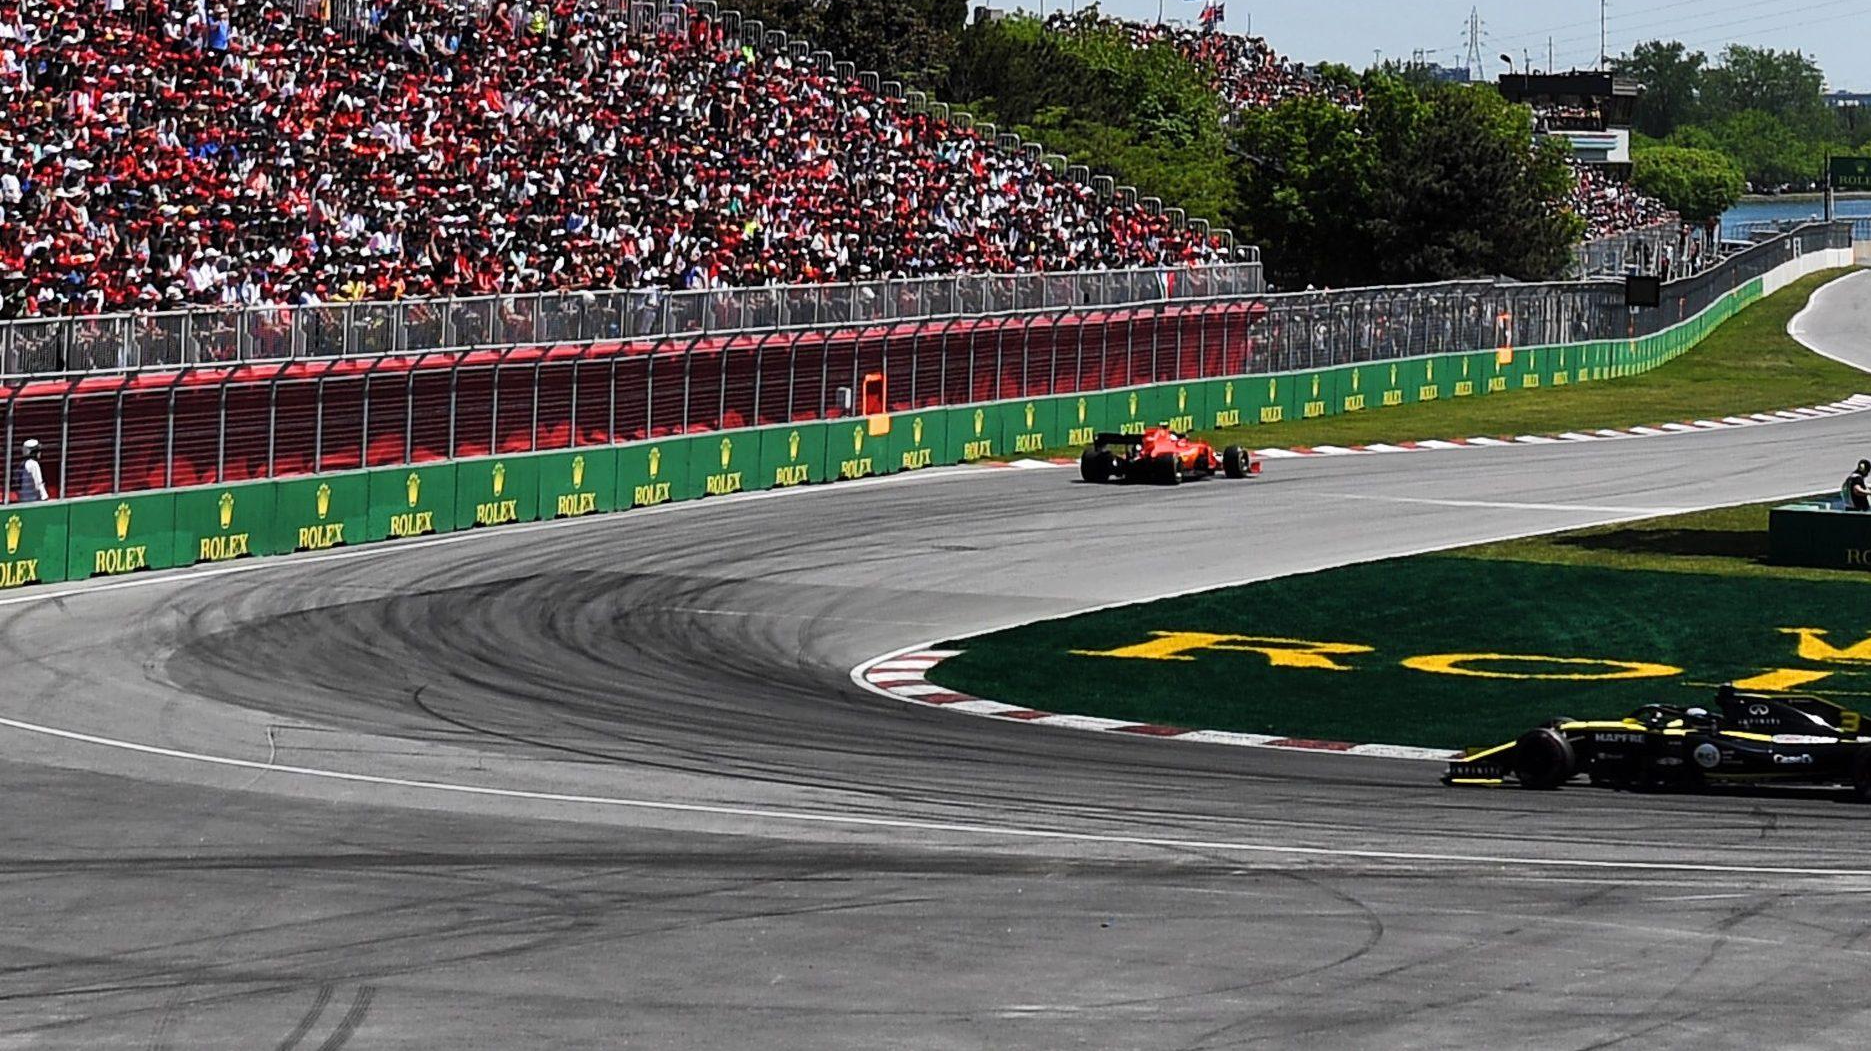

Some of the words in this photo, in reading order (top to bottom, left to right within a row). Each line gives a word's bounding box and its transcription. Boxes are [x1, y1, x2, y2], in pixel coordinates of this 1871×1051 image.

[1015, 433, 1043, 452] ROLEX
[1068, 427, 1094, 446] ROLEX
[902, 448, 931, 470] ROLEX
[964, 440, 991, 460] ROLEX
[776, 464, 808, 486] ROLEX
[841, 458, 872, 479] ROLEX
[634, 482, 671, 505] ROLEX
[706, 472, 742, 494] ROLEX
[476, 500, 517, 524] ROLEX
[557, 493, 596, 517] ROLEX
[390, 511, 434, 537] ROLEX
[200, 534, 249, 561] ROLEX
[299, 524, 344, 550] ROLEX
[95, 546, 146, 574] ROLEX
[0, 558, 38, 588] OLEX
[1840, 711, 1860, 732] 3
[1595, 733, 1645, 743] MAPFRE
